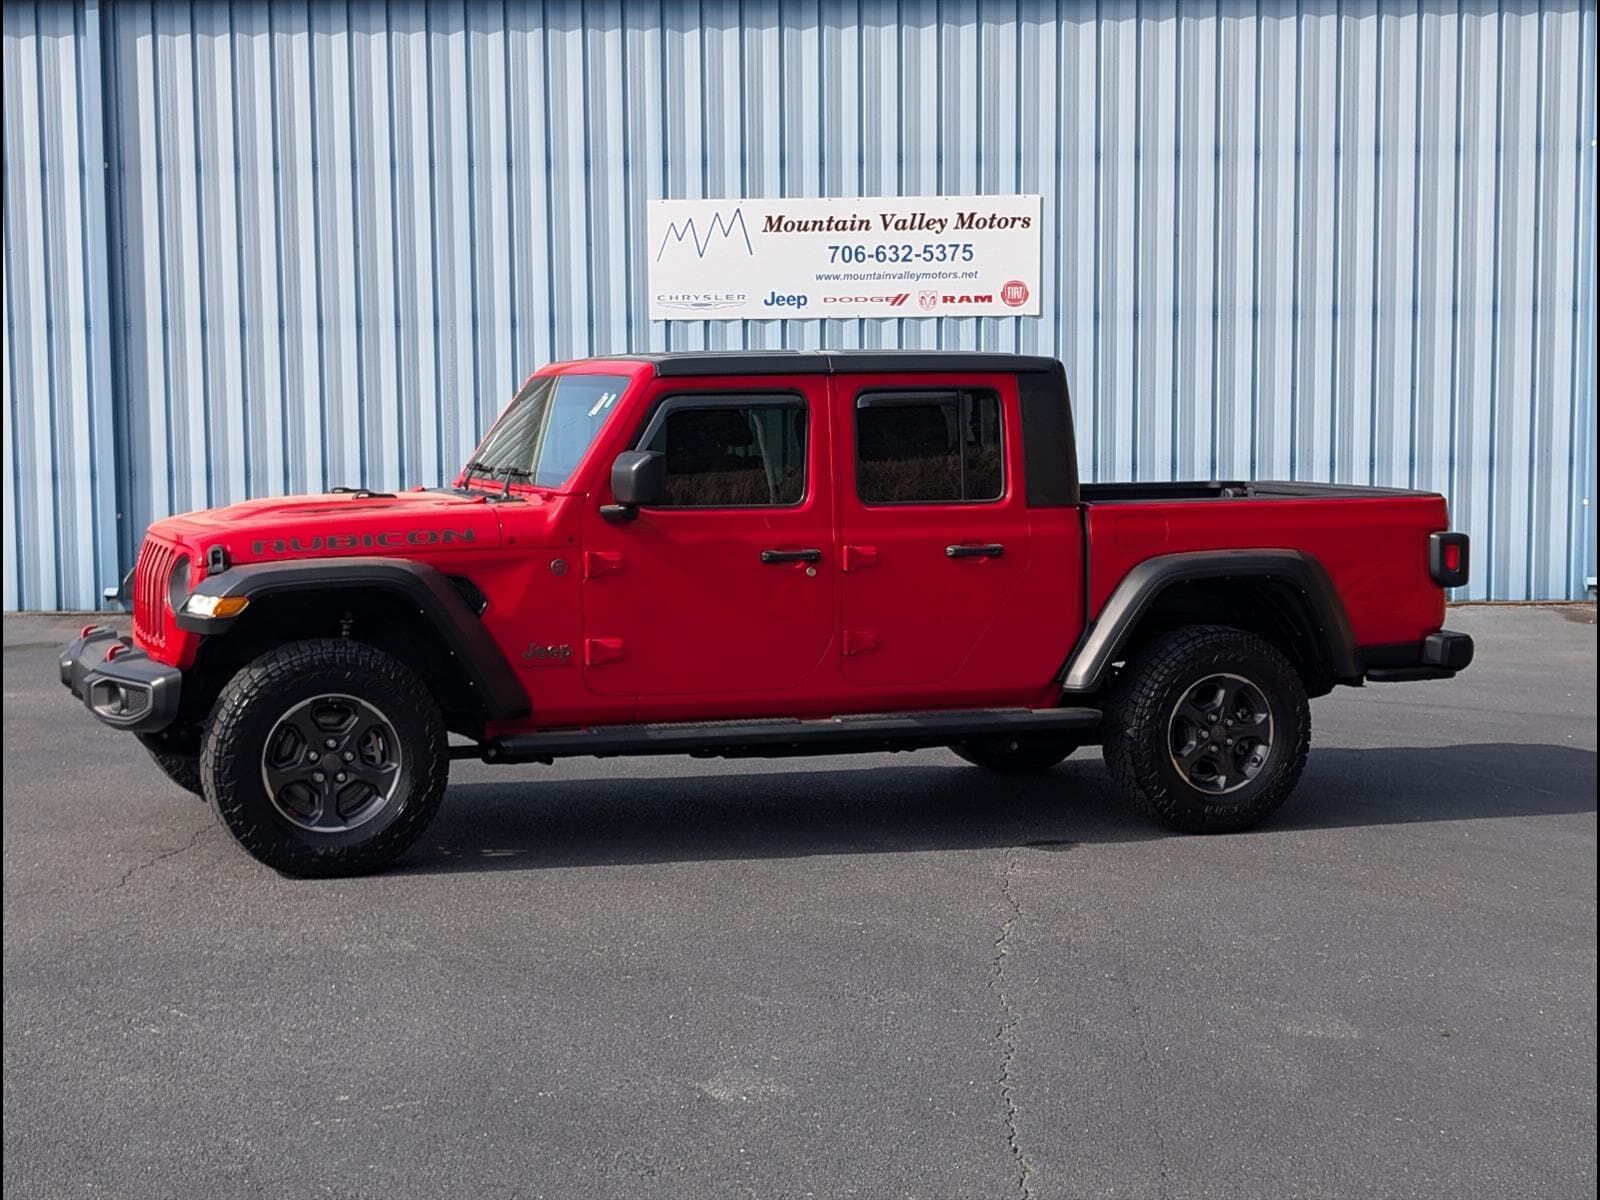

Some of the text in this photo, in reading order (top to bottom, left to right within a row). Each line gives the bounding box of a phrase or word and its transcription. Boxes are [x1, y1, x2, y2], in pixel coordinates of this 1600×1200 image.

[762, 211, 1031, 235] Mountain Valley Motors
[828, 243, 974, 264] 706-632-5375
[815, 270, 978, 283] www.mountainvalleymotors.net
[764, 291, 808, 309] Jeep
[823, 296, 895, 304] DODGE
[942, 295, 993, 304] RAM
[1007, 286, 1023, 299] FIAT
[252, 528, 476, 555] RUBICON
[521, 641, 573, 663] Jeep
